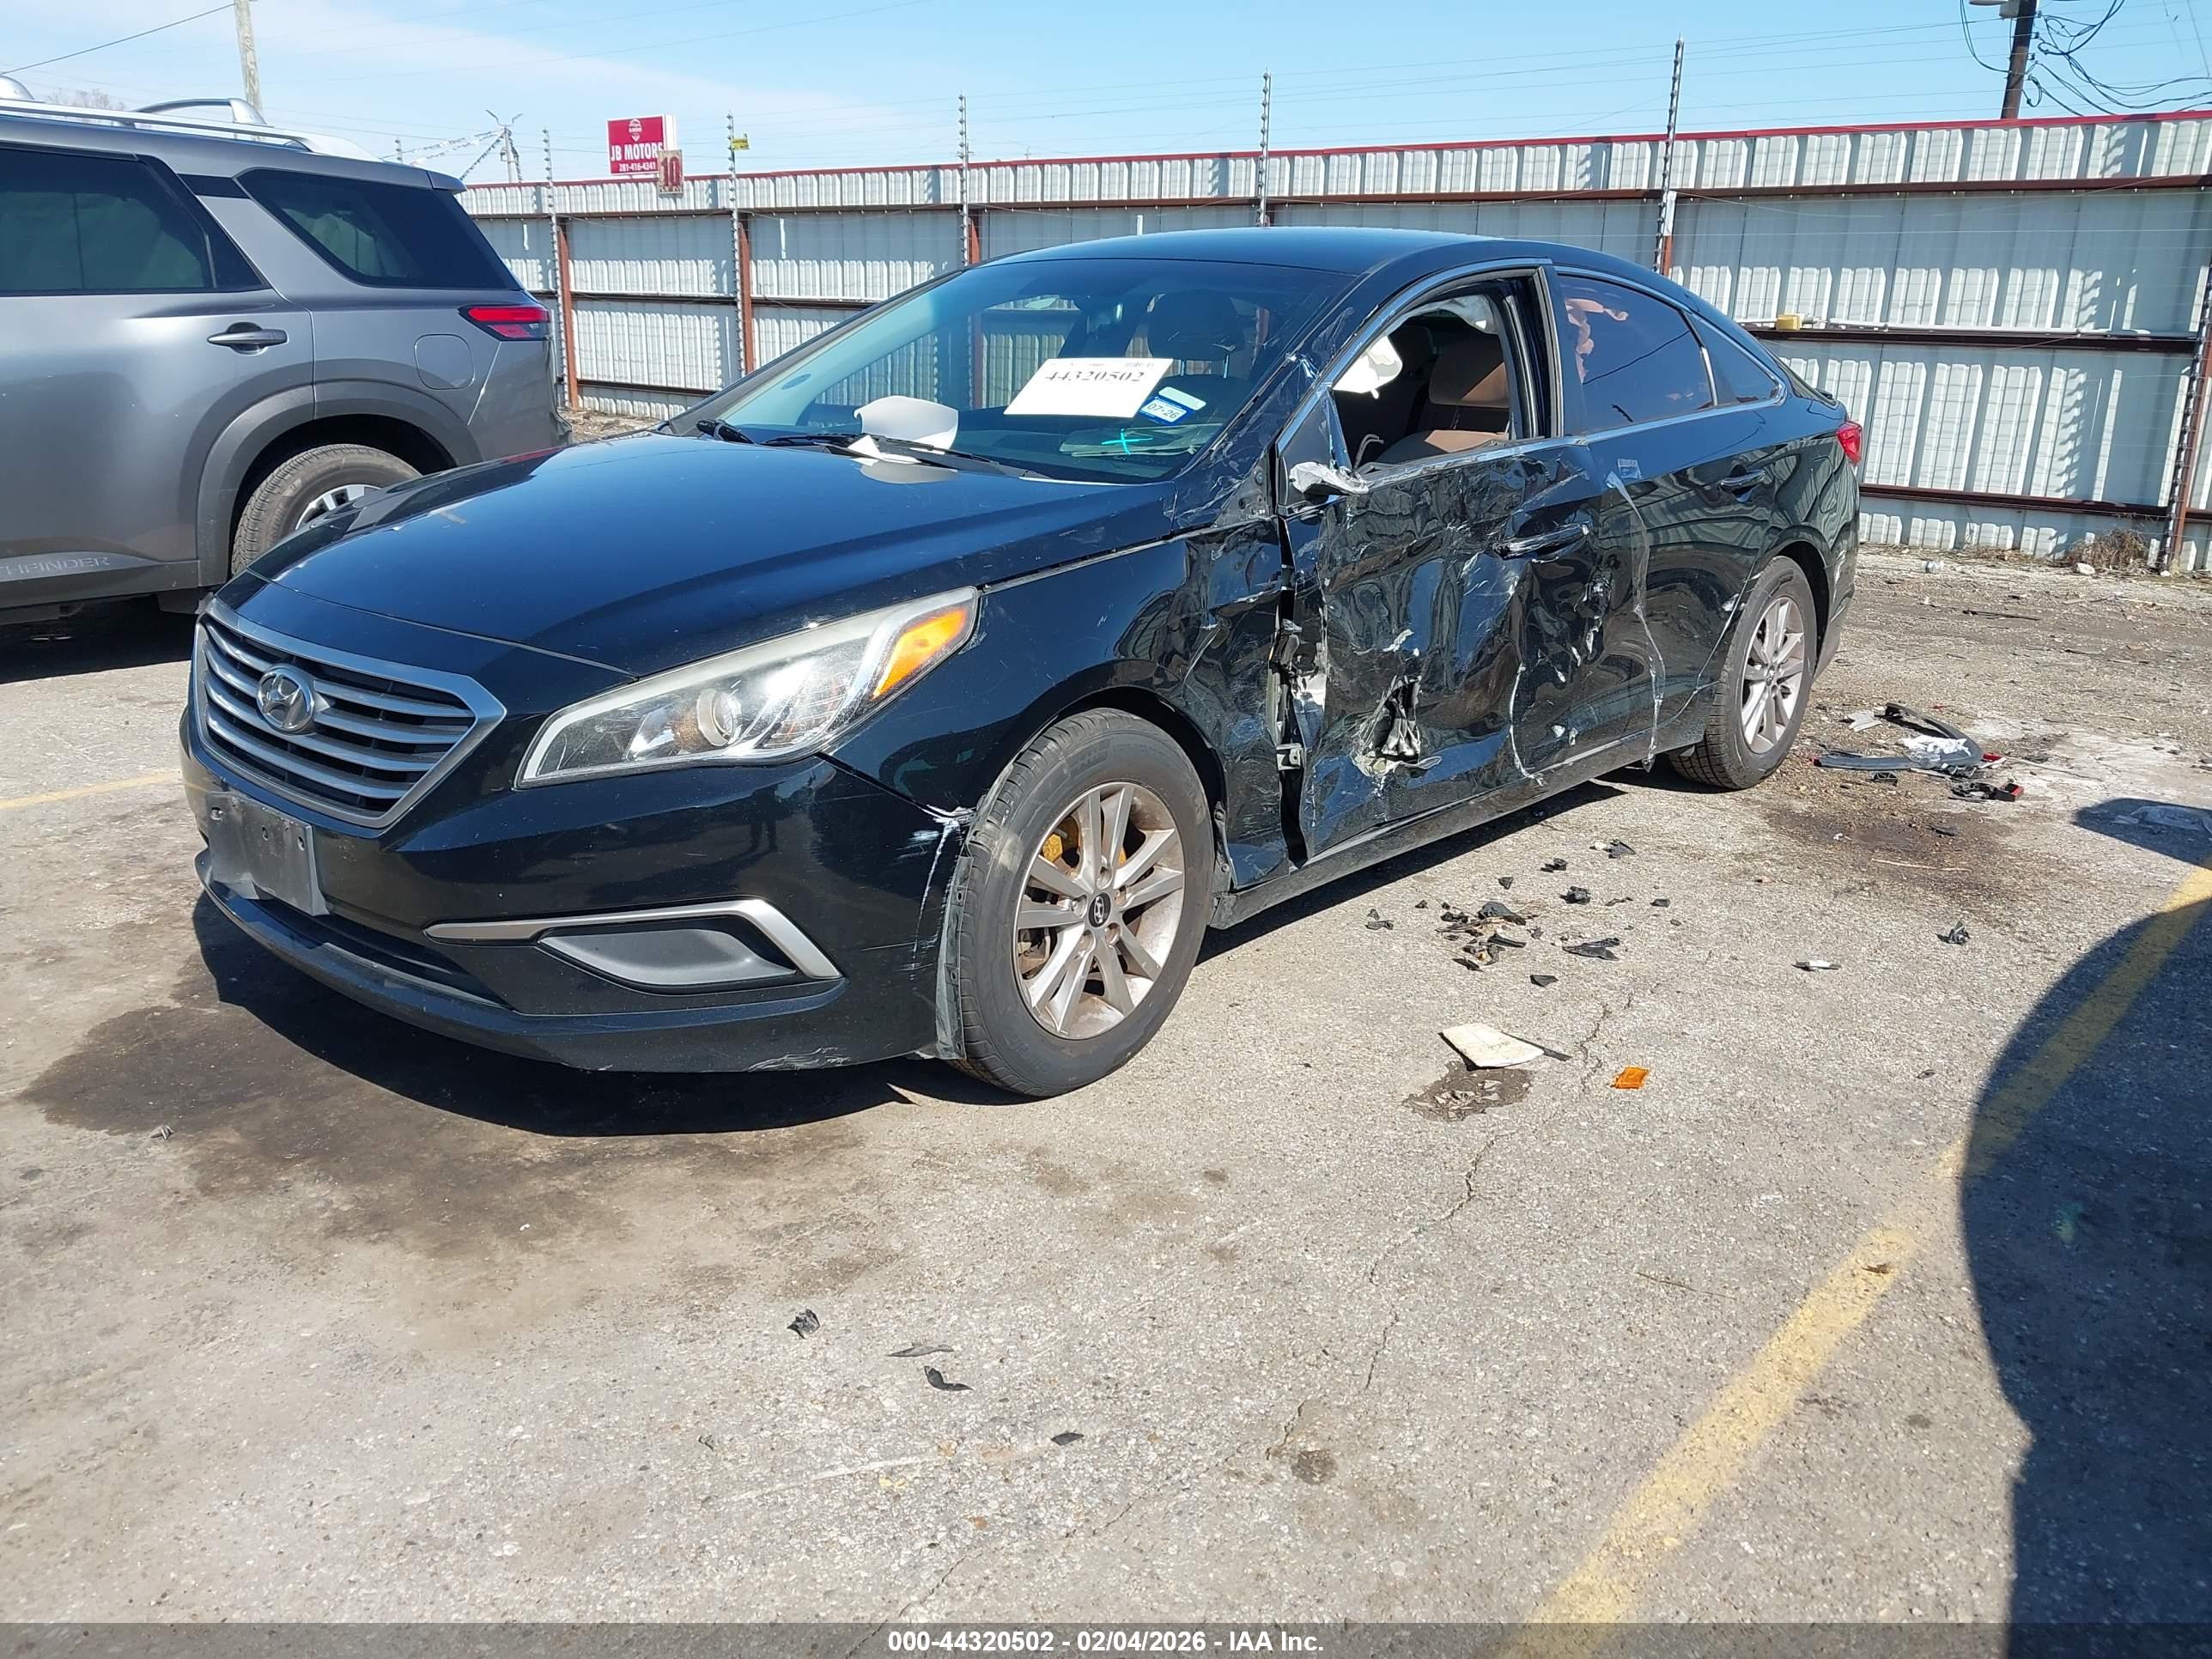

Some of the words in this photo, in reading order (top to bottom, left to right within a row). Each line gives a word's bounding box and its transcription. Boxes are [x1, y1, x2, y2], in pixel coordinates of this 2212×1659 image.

[611, 144, 622, 161] JB
[660, 156, 681, 187] 10
[1044, 370, 1145, 382] 44320502
[0, 556, 110, 575] HFINDER
